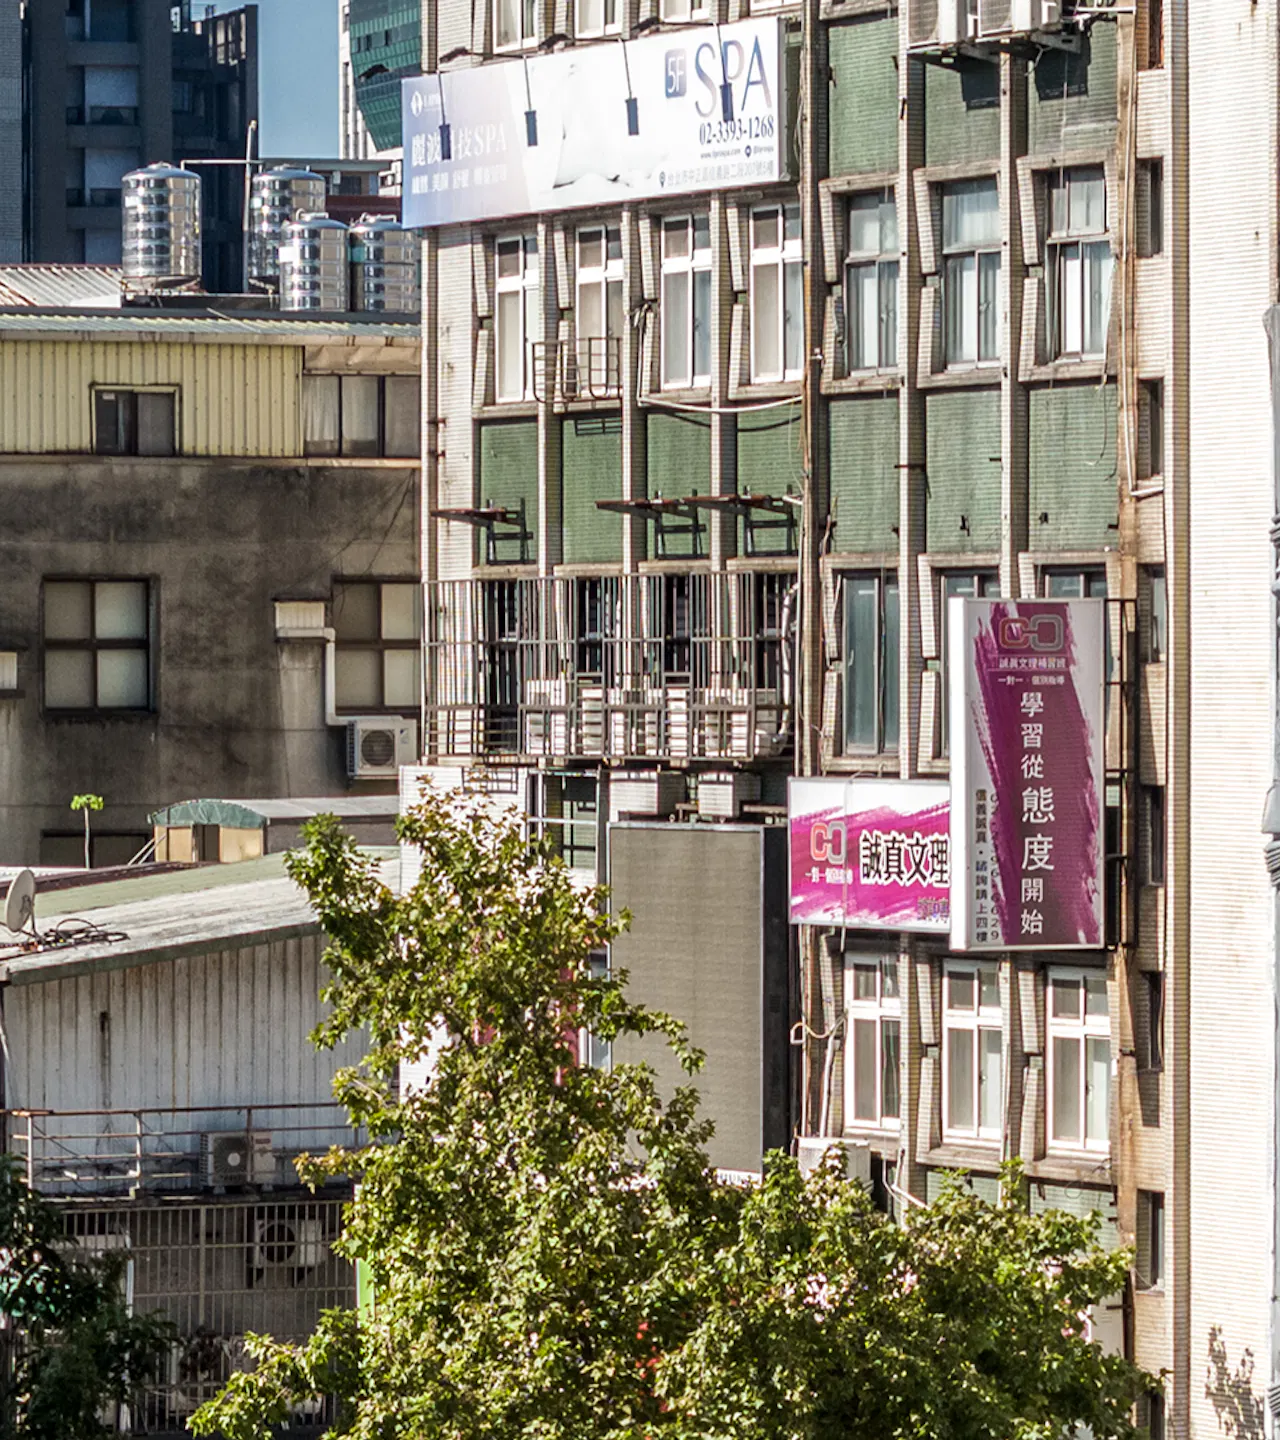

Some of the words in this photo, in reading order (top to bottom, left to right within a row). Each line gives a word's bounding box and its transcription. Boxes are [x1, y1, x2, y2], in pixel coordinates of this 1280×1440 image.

[668, 52, 686, 94] 5F
[695, 34, 773, 119] SPA
[699, 114, 775, 145] 02-3393-1268
[1020, 691, 1056, 936] 學習從態度開始
[861, 829, 951, 887] 誠真文理
